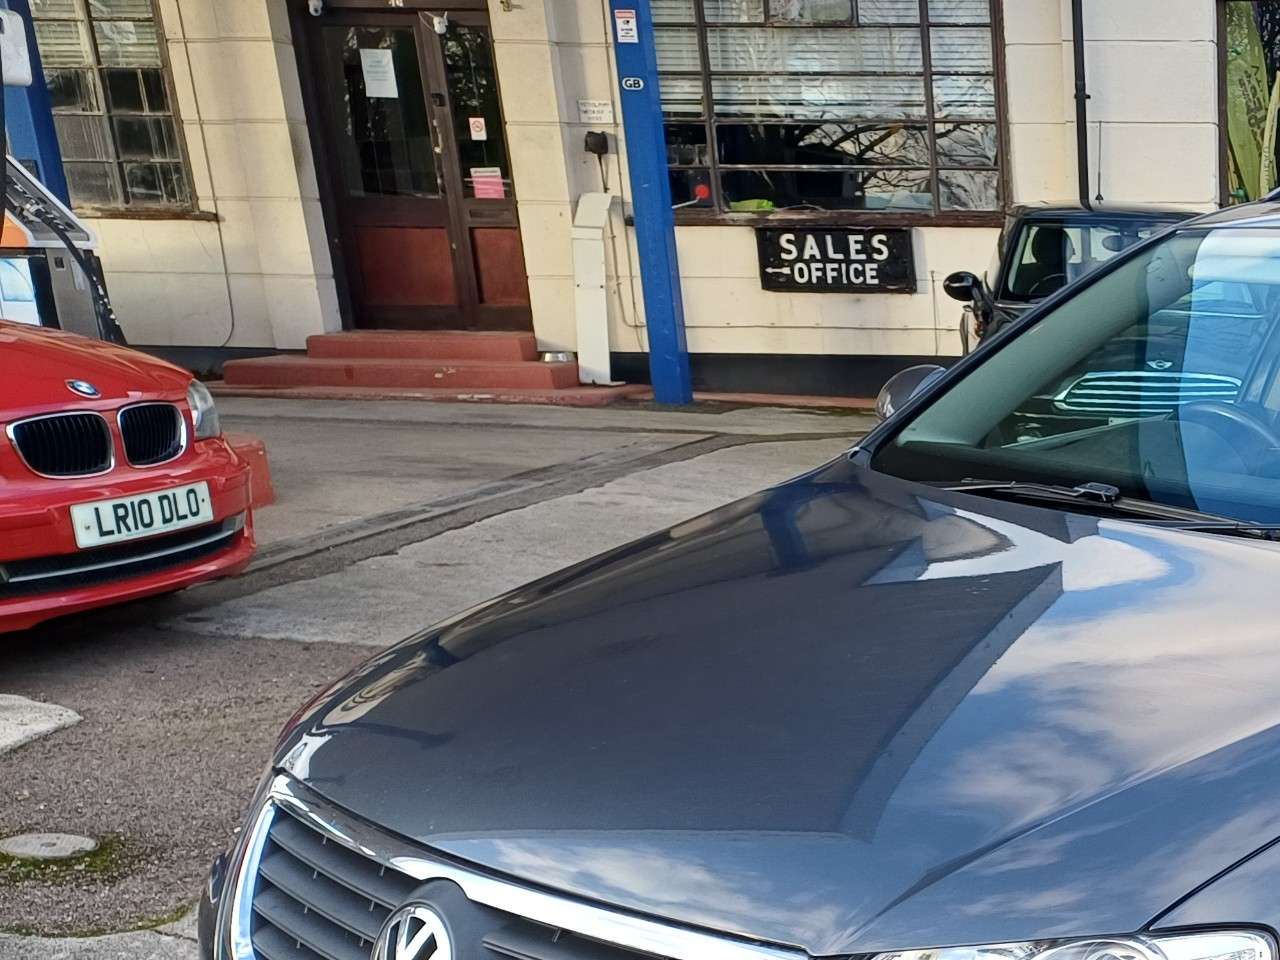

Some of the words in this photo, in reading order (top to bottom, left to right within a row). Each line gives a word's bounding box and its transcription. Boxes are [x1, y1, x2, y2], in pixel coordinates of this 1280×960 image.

[624, 78, 641, 89] GB
[778, 233, 889, 261] SALES
[793, 262, 879, 285] OFFICE
[93, 498, 154, 538] LR10
[158, 487, 201, 526] DLO
